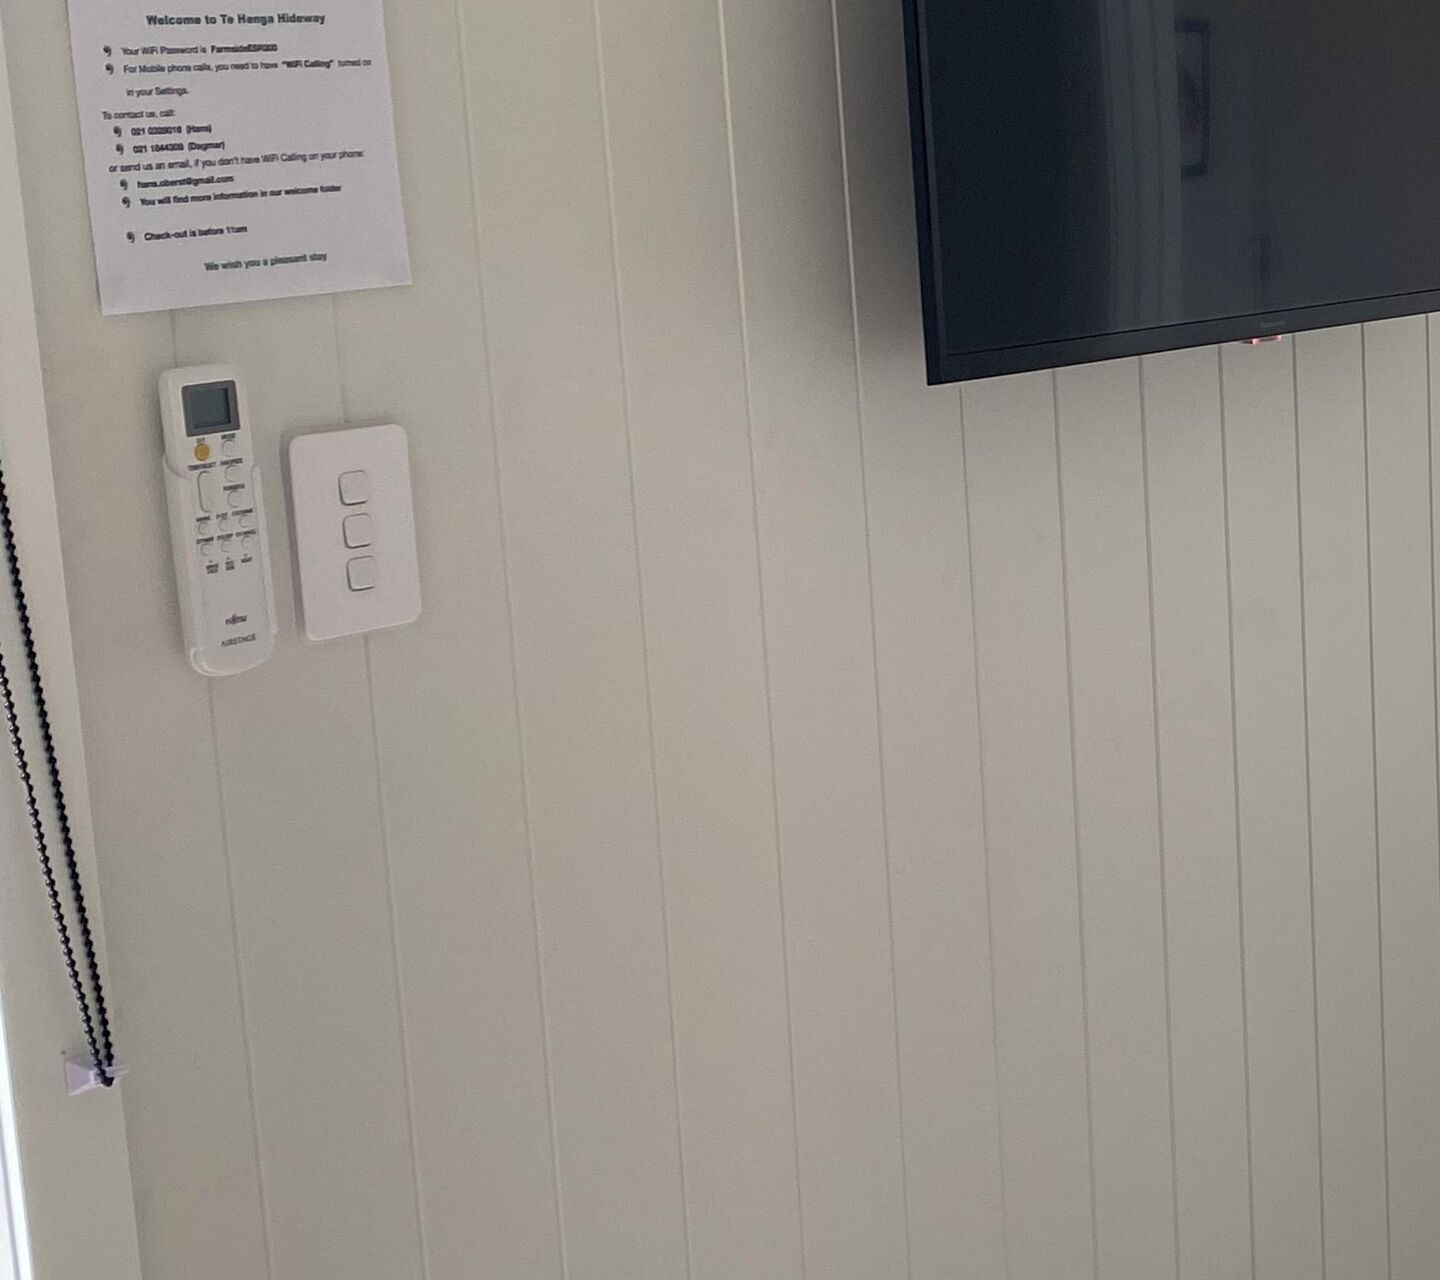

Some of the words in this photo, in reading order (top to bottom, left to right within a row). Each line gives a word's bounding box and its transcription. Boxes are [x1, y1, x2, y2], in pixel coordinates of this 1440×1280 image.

[146, 14, 201, 26] Welcome
[204, 14, 217, 25] to
[219, 13, 234, 24] Te
[237, 12, 275, 26] Henga
[277, 12, 326, 25] Hideway
[121, 46, 139, 55] Your
[160, 45, 198, 55] Password
[123, 64, 137, 74] For
[139, 64, 166, 73] Mobile
[167, 63, 192, 75] phone
[215, 63, 229, 73] you
[231, 61, 249, 70] need
[251, 62, 259, 70] to
[260, 61, 278, 70] have
[126, 87, 134, 97] in
[135, 88, 153, 98] your
[102, 110, 112, 120] To
[114, 110, 144, 119] contact
[108, 164, 118, 173] or
[120, 163, 141, 173] send
[143, 162, 153, 172] us
[155, 161, 165, 170] an
[202, 159, 216, 170] you
[241, 156, 260, 165] have
[281, 152, 307, 163] Calling
[309, 153, 319, 161] on
[320, 151, 336, 162] your
[140, 197, 156, 207] You
[158, 196, 171, 205] will
[173, 195, 189, 204] find
[190, 194, 211, 203] more
[213, 190, 258, 201] information
[269, 189, 282, 197] our
[284, 186, 318, 196] welcome
[144, 230, 188, 242] Check-out
[189, 228, 197, 238] is
[198, 226, 224, 237] before
[226, 225, 248, 235] 11am
[204, 261, 219, 271] We
[221, 260, 242, 270] wish
[244, 258, 260, 270] you
[270, 253, 308, 267] pleasant
[309, 252, 327, 263] stay
